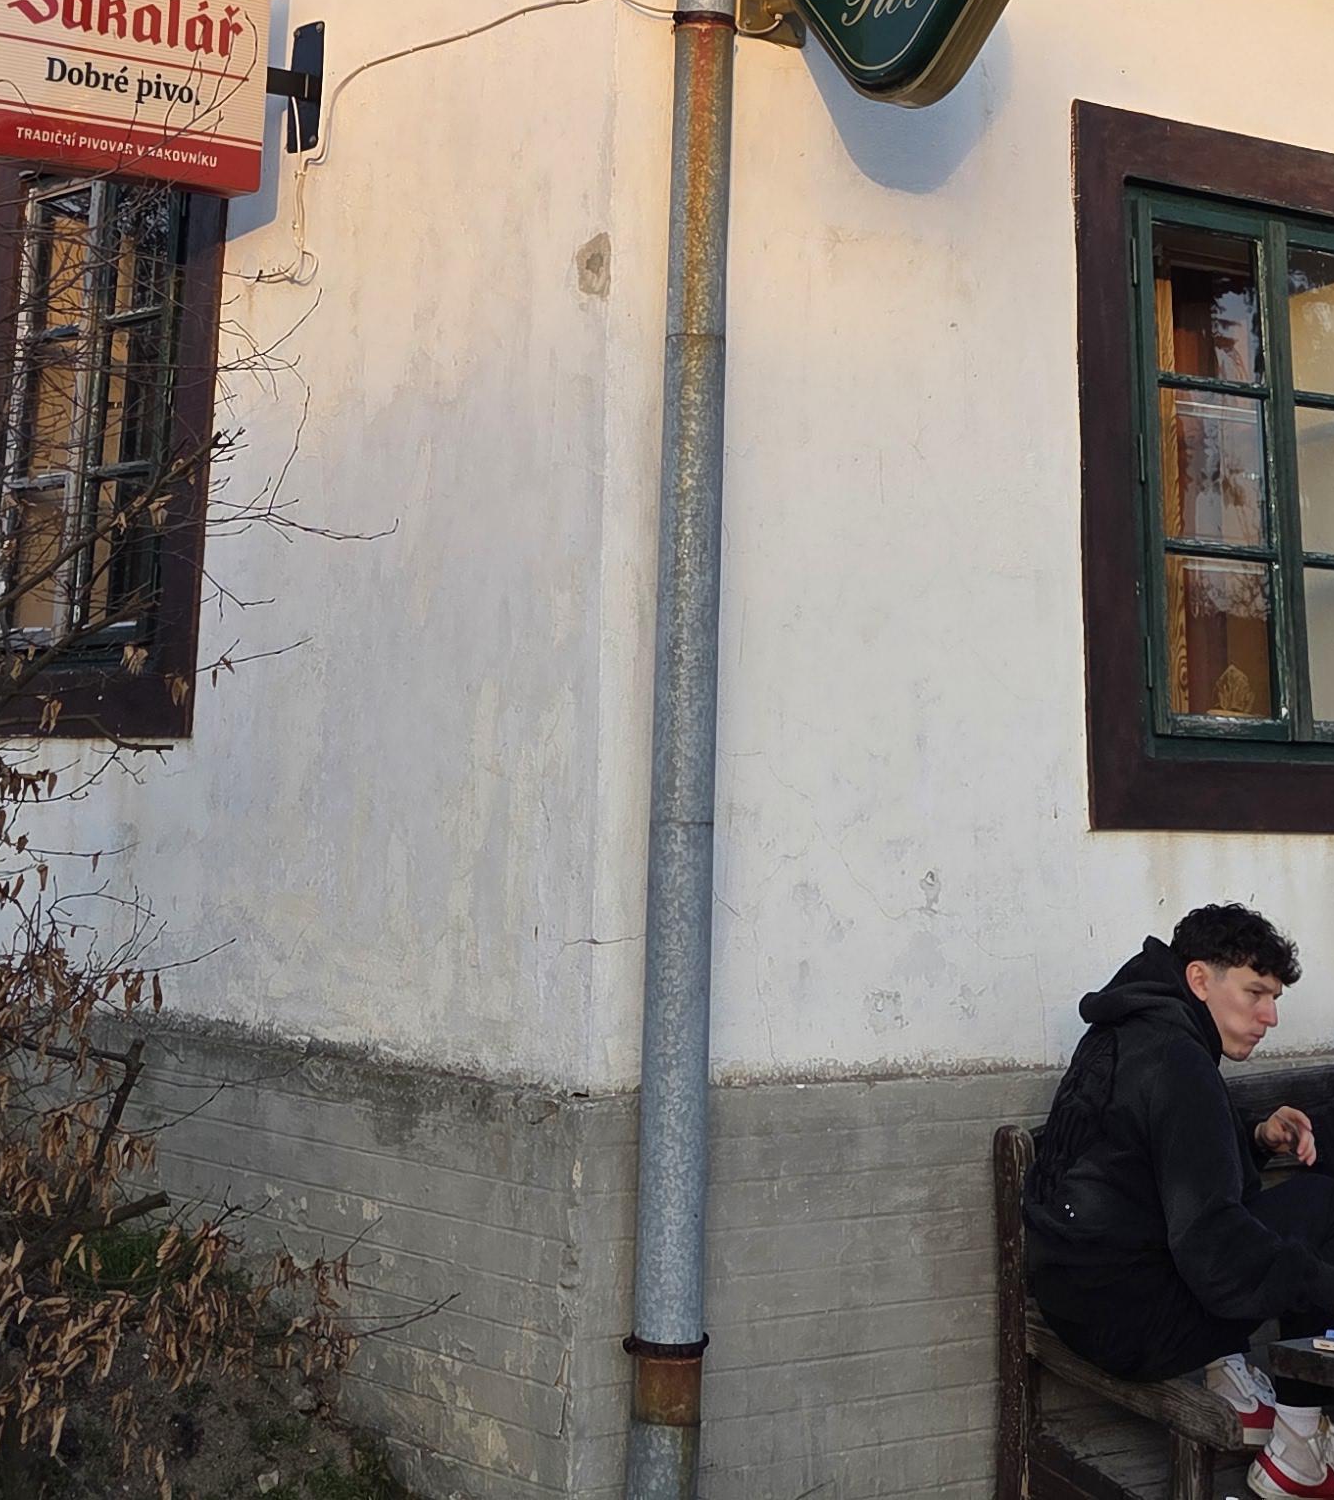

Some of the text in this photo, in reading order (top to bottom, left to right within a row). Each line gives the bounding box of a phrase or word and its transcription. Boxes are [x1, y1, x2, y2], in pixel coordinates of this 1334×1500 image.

[45, 56, 201, 106] Dobré pivo.
[16, 126, 77, 147] TRADIČNÍ
[78, 136, 133, 155] PIVOVAR
[136, 144, 146, 157] V
